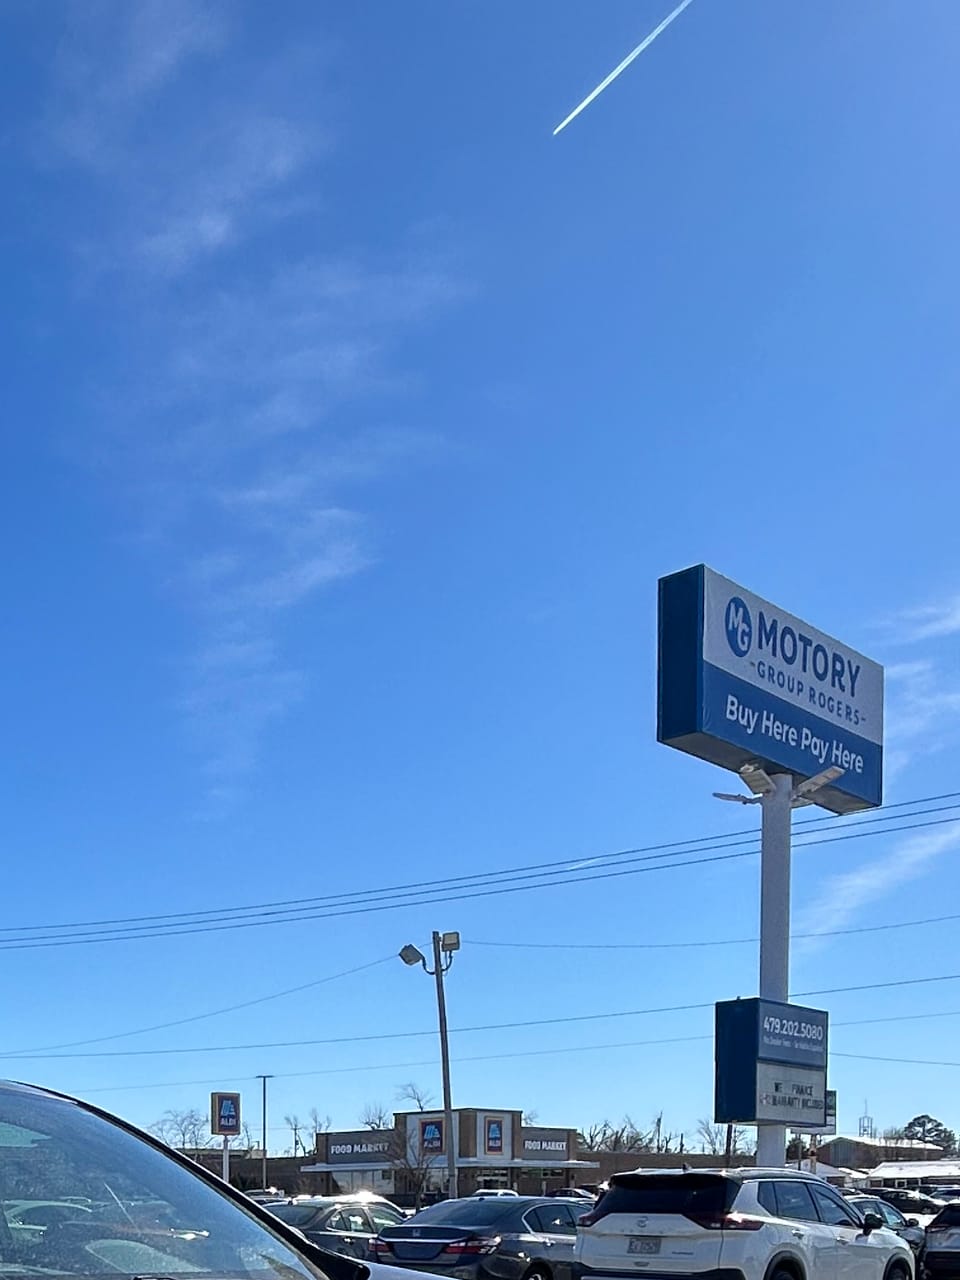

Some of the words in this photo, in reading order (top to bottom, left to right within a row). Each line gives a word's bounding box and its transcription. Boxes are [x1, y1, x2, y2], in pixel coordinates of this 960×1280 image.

[757, 611, 860, 697] MOTORY
[726, 695, 758, 734] Buy
[761, 710, 798, 746] Here
[801, 727, 831, 764] Pay
[832, 740, 864, 773] Here
[763, 1016, 823, 1041] 479.202.5080
[220, 1117, 237, 1126] ALDI
[331, 1144, 352, 1154] FOOD
[353, 1142, 390, 1153] MARKET
[524, 1140, 540, 1150] FOOD
